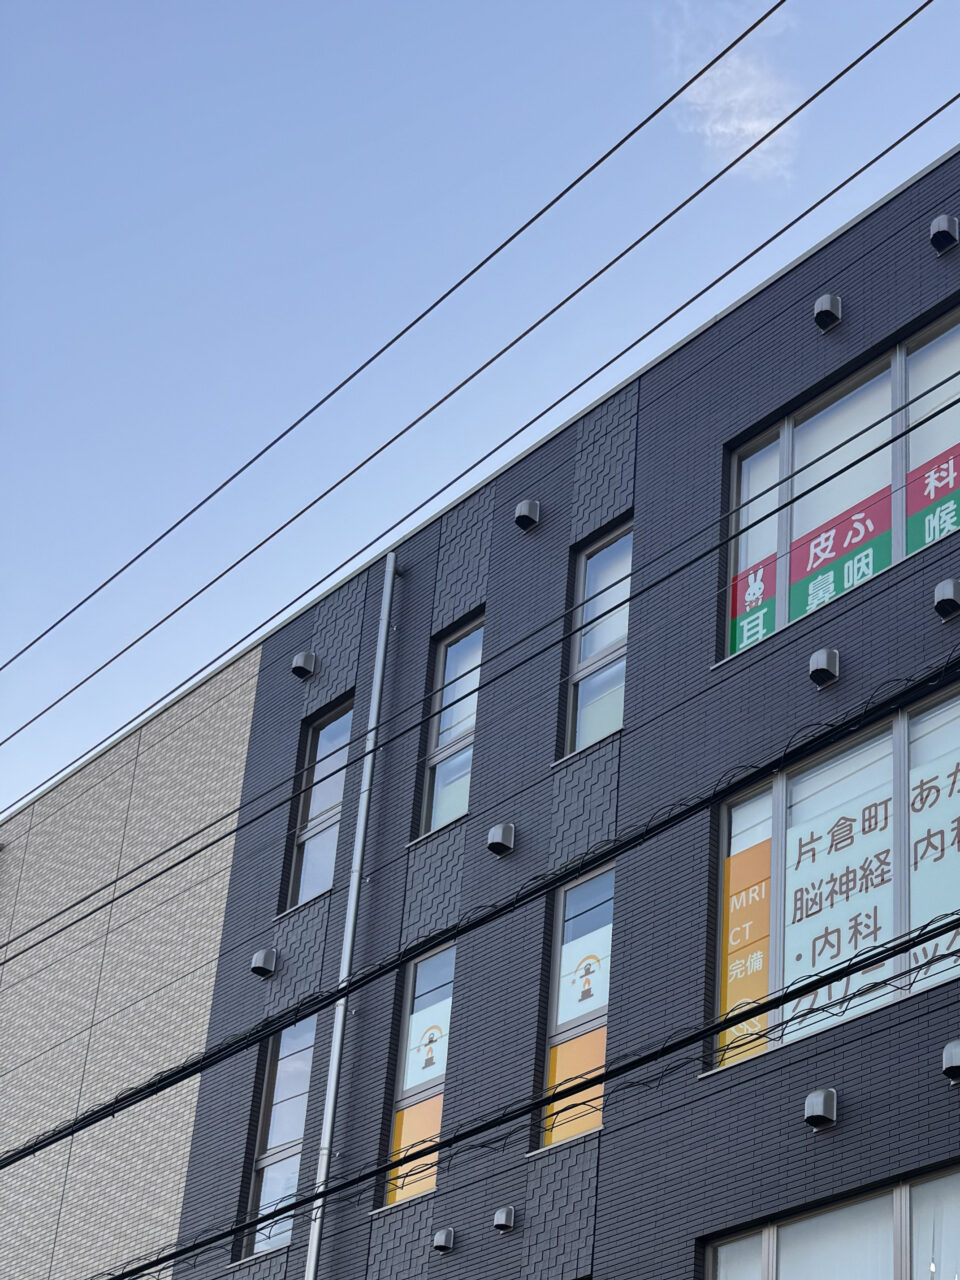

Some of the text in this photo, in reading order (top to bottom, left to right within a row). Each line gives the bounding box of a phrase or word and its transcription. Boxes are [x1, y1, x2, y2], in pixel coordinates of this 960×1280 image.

[729, 880, 767, 913] MRI
[728, 920, 753, 946] CT
[727, 950, 764, 984] 完備
